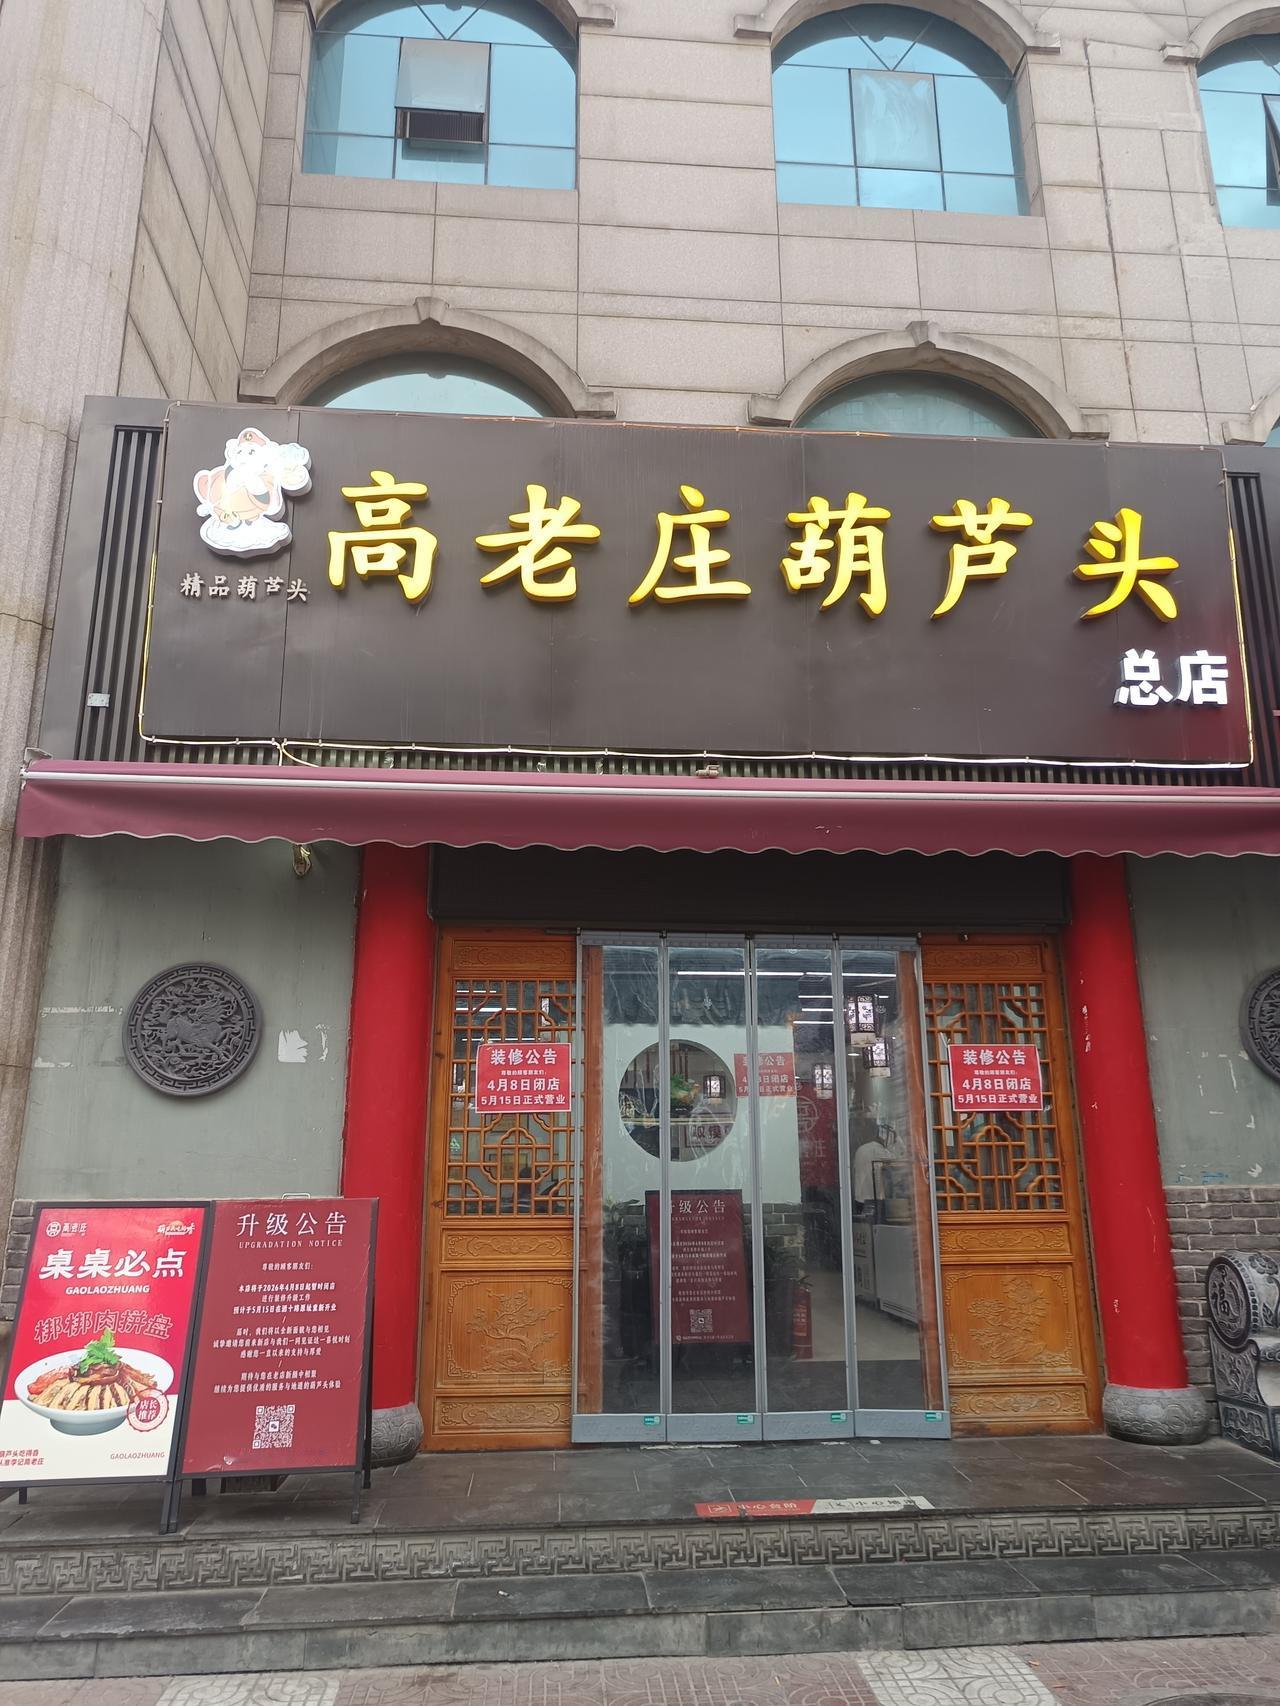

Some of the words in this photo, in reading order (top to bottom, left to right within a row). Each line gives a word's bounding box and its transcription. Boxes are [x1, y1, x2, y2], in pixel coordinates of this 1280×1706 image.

[327, 470, 1179, 623] 高老庄葫芦头
[180, 572, 309, 602] 精品葫芦头
[1114, 649, 1229, 707] 总店
[491, 1048, 558, 1065] 装修公告
[963, 1050, 1026, 1065] 装修公告
[487, 1078, 560, 1091] 4月8日闭店
[962, 1078, 1032, 1090] 4月8日闭店
[481, 1094, 566, 1105] 5月15日正式营业
[958, 1094, 1039, 1104] 5月15日正式营业
[236, 1211, 347, 1237] 升级公告
[238, 1240, 303, 1249] UPGRADATION
[308, 1239, 344, 1248] NOTICE
[39, 1248, 187, 1280] 桌桌必点
[65, 1284, 150, 1295] GAOLAOZHUANG
[34, 1308, 173, 1344] 梆梆肉拼盘
[110, 1451, 165, 1460] GAOLAOZHUANG
